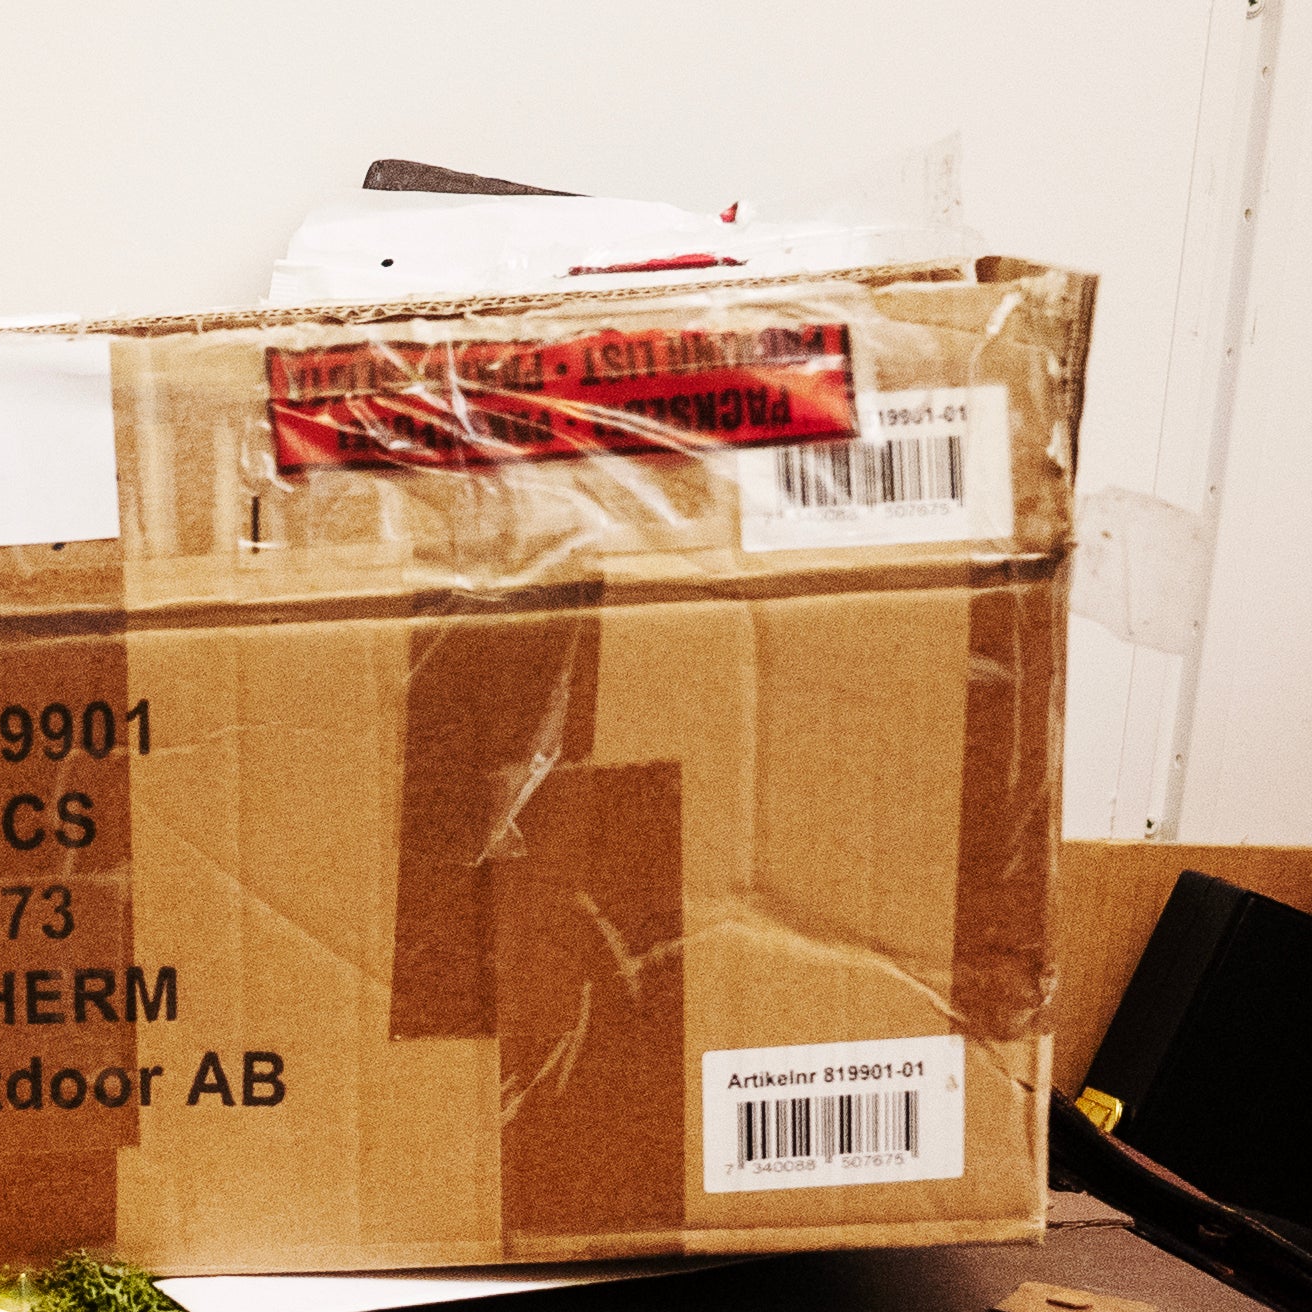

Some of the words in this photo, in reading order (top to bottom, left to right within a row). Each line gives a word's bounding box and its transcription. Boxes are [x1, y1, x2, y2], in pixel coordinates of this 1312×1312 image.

[186, 1051, 288, 1107] AB
[727, 1070, 818, 1090] Artikelnr
[822, 1060, 926, 1084] 819901-01
[752, 1159, 817, 1174] 340088
